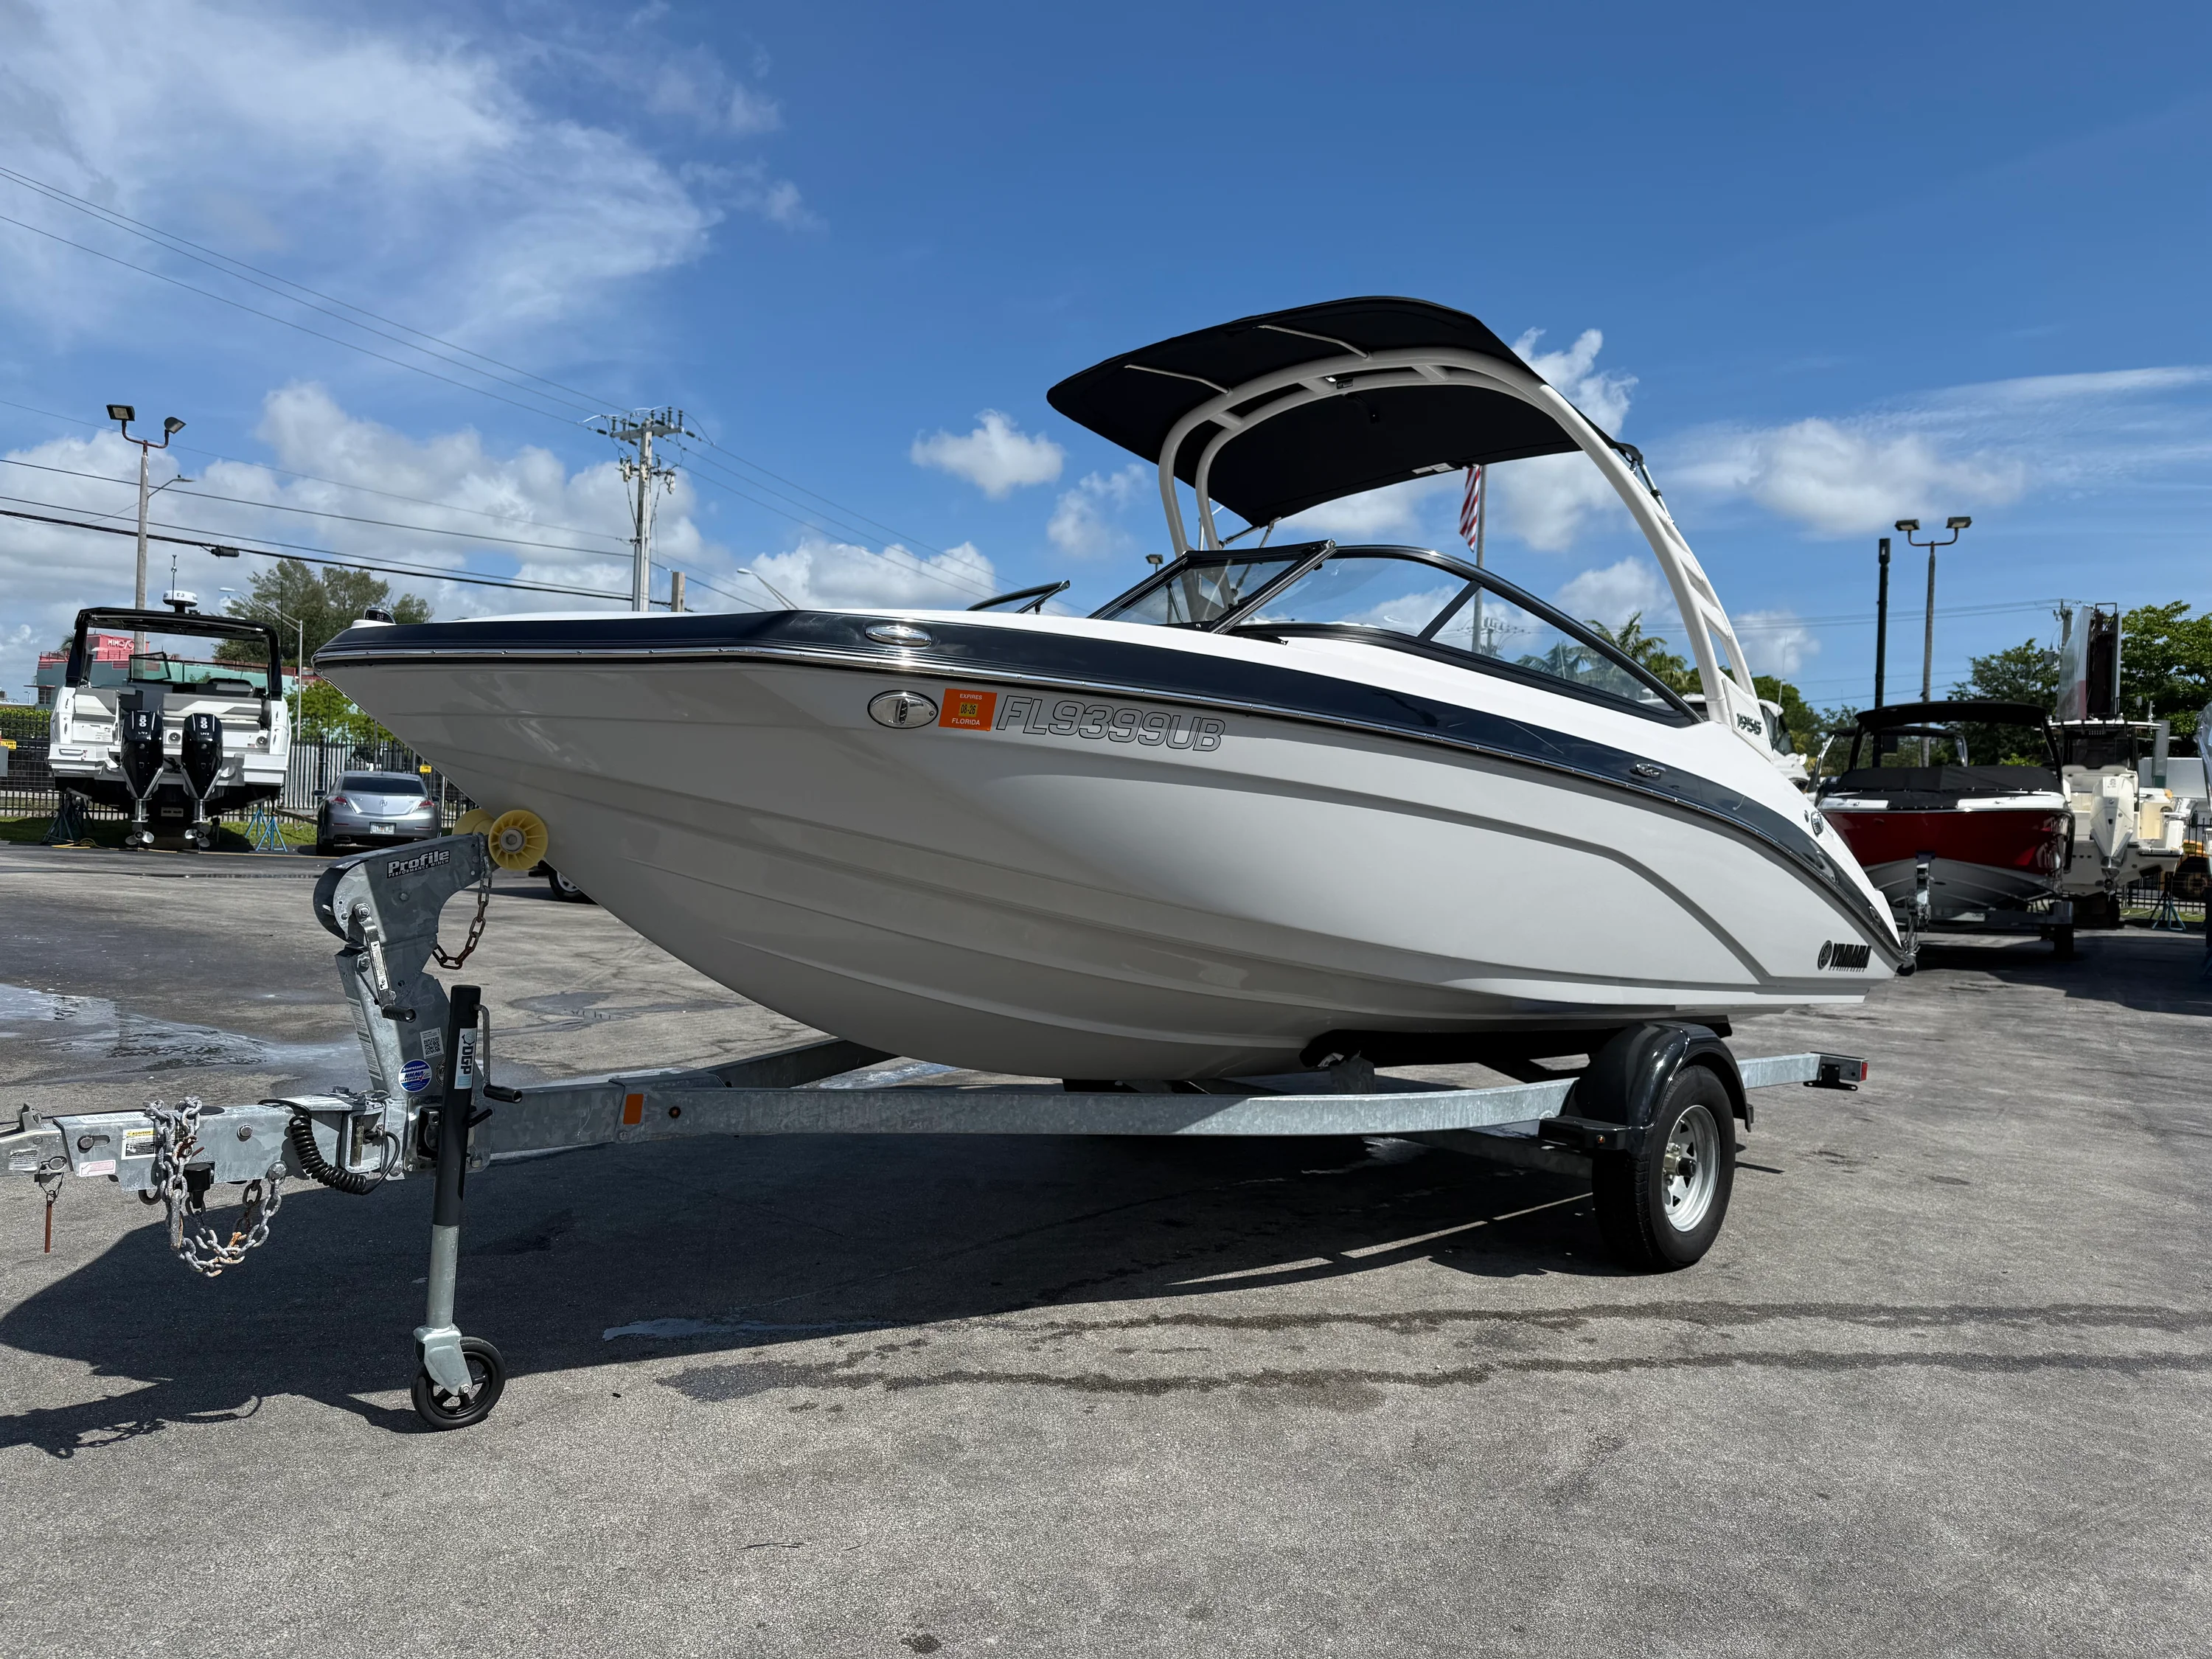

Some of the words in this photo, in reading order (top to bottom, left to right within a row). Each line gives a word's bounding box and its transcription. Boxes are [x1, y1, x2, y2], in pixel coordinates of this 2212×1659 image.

[960, 704, 976, 714] 08-26
[951, 717, 981, 726] FLORIDA
[995, 695, 1226, 752] FL9399UB
[388, 850, 450, 874] Profile
[389, 865, 428, 877] PERFORMANCE
[431, 858, 449, 866] WINCH
[1829, 942, 1872, 973] YAMAHA
[460, 1046, 474, 1075] DGP
